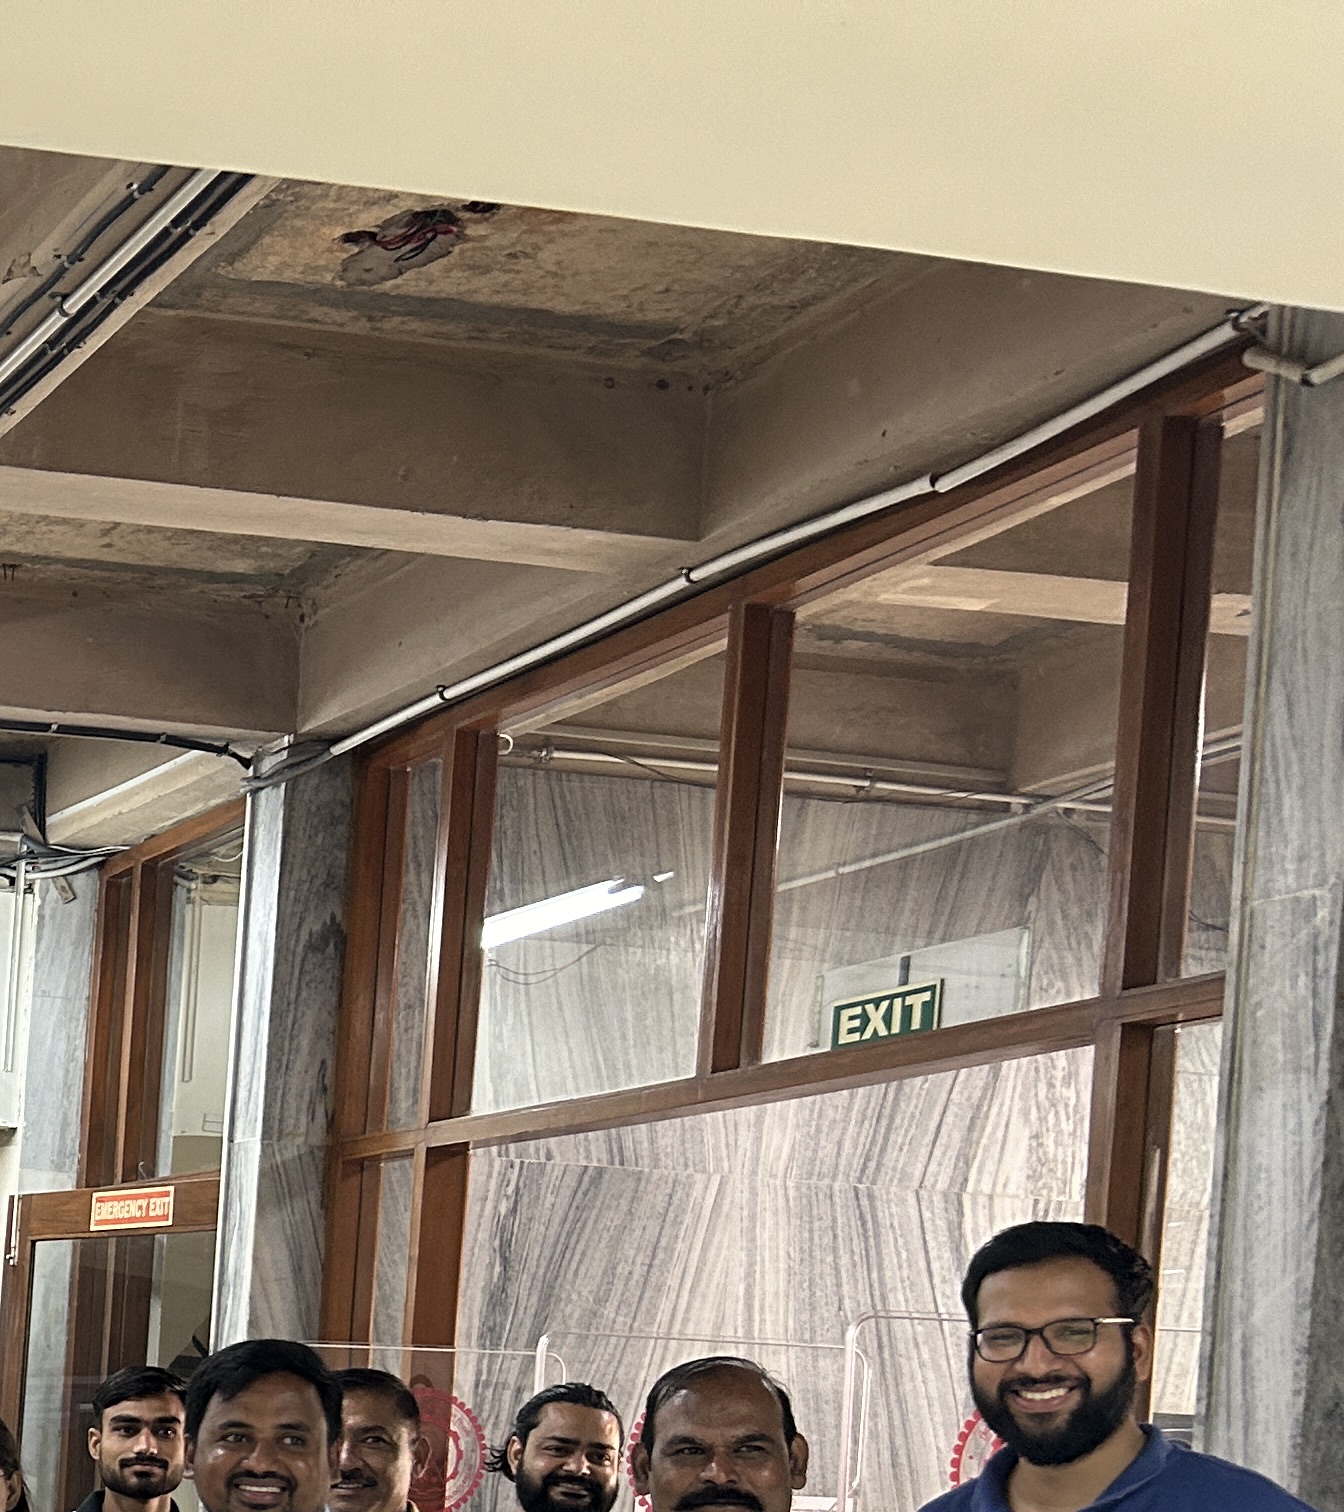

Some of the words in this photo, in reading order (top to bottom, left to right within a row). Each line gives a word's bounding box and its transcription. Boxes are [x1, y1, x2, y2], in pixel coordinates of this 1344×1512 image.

[838, 991, 931, 1044] EXIT
[95, 1199, 148, 1220] EMERGENCY
[149, 1197, 170, 1216] EXIT
